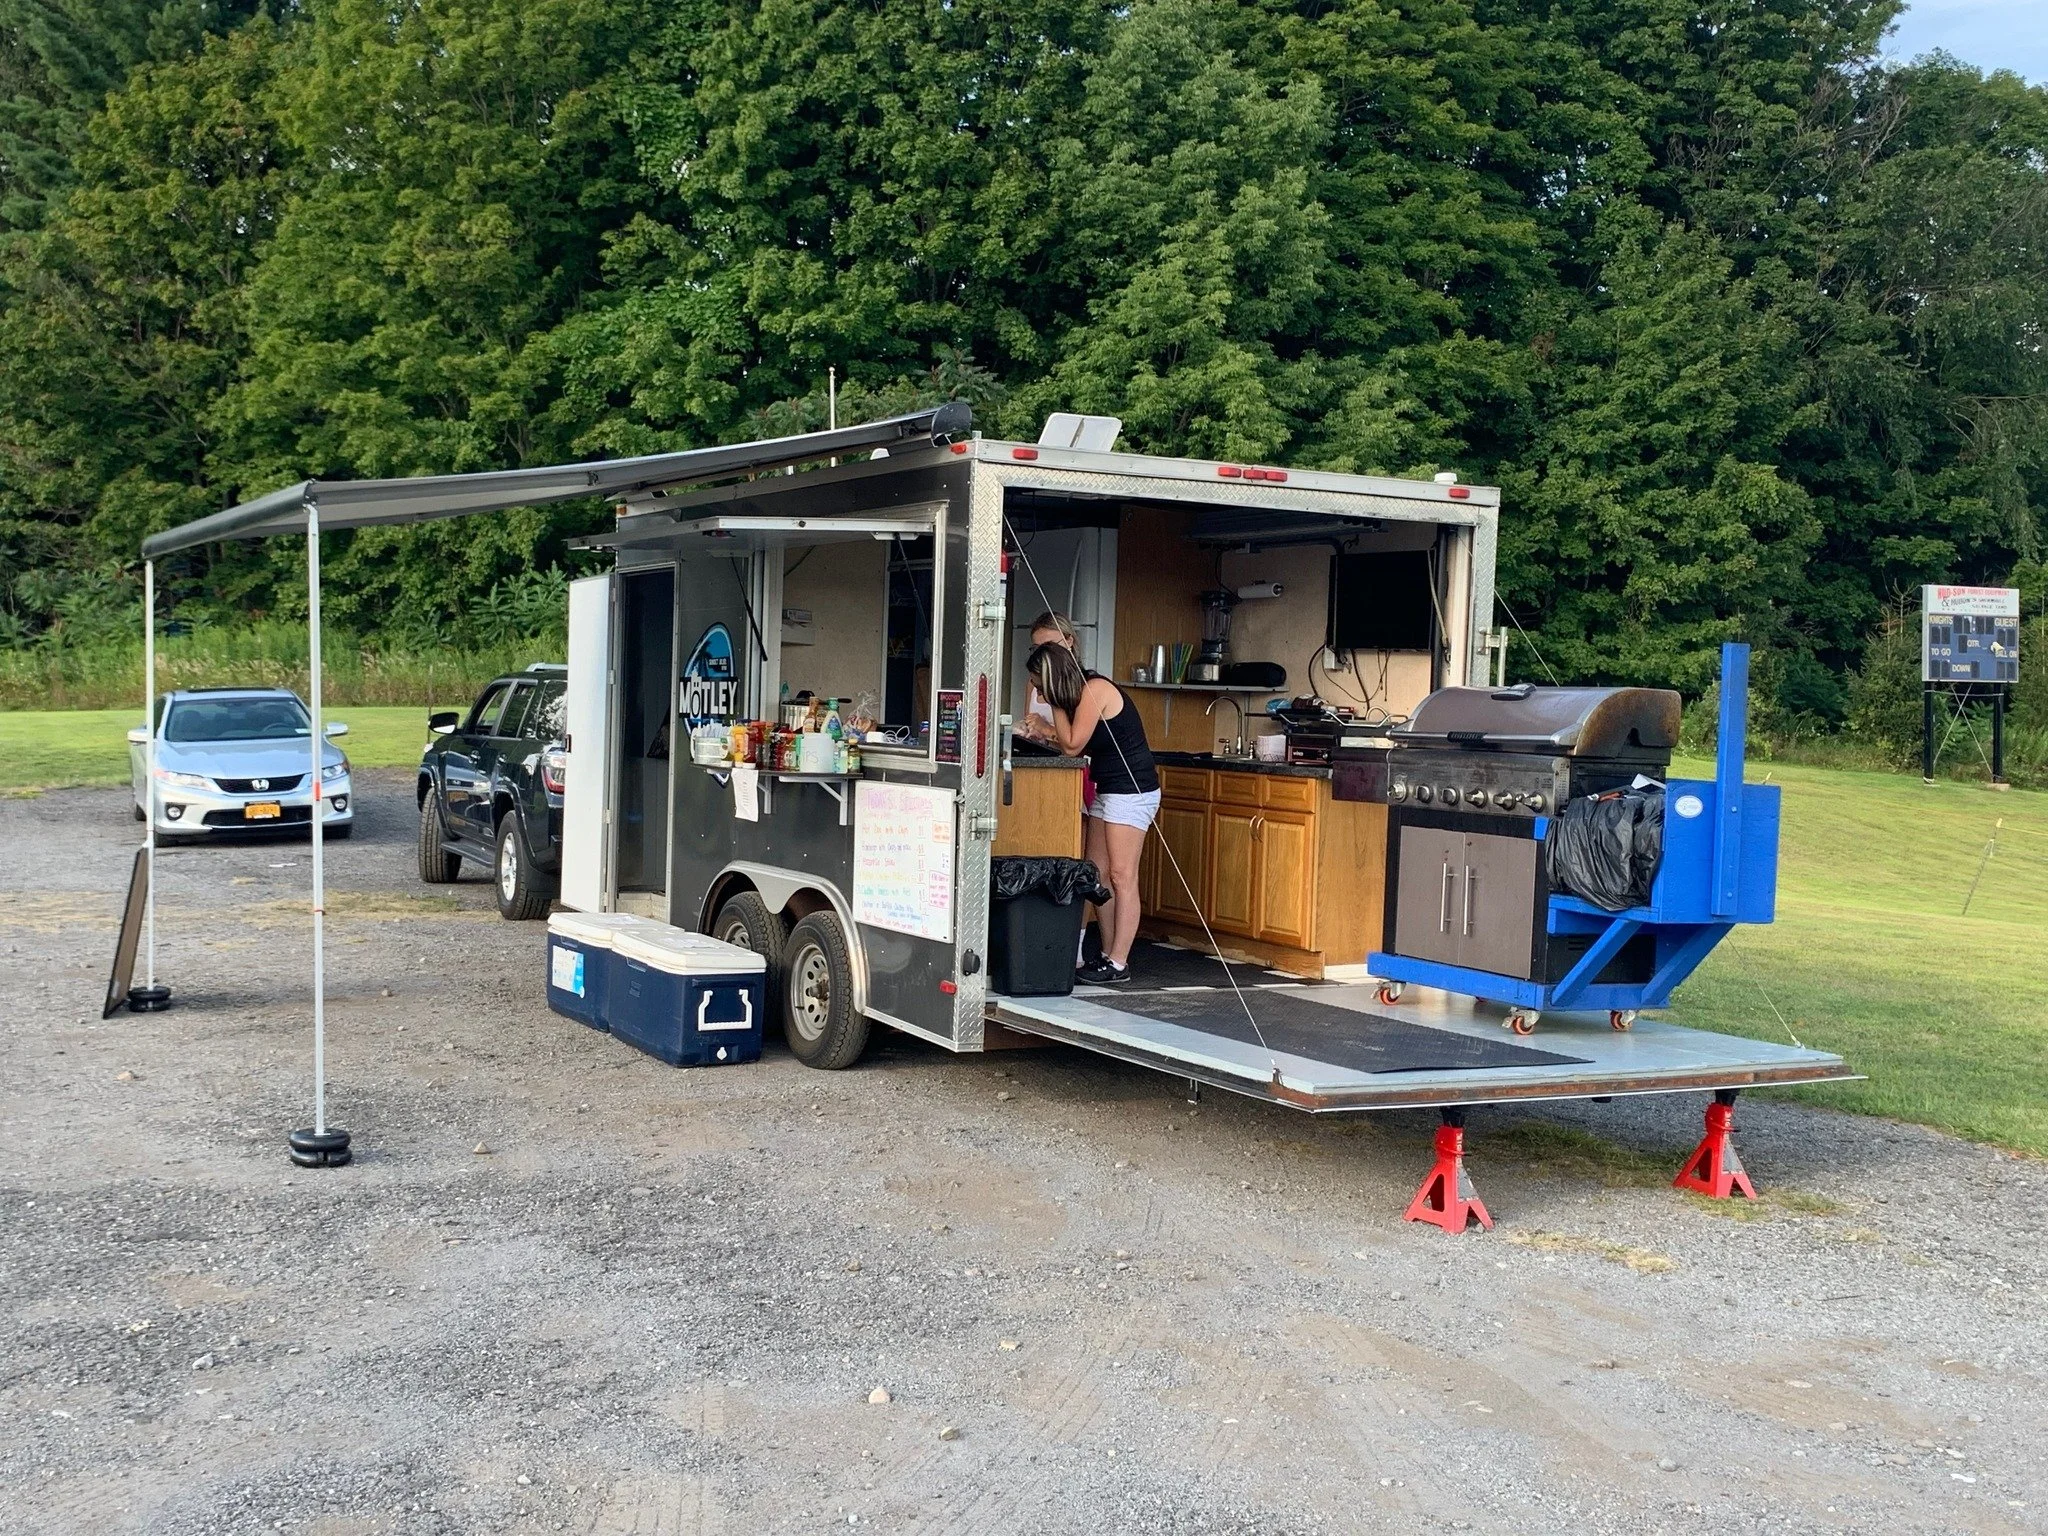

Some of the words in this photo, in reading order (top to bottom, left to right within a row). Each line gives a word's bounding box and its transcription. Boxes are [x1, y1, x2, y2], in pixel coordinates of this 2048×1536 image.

[1929, 615, 1953, 625] KNIGHTS
[1995, 618, 2017, 627] GUEST
[1941, 648, 1951, 656] GO
[1952, 664, 1970, 672] DOWN
